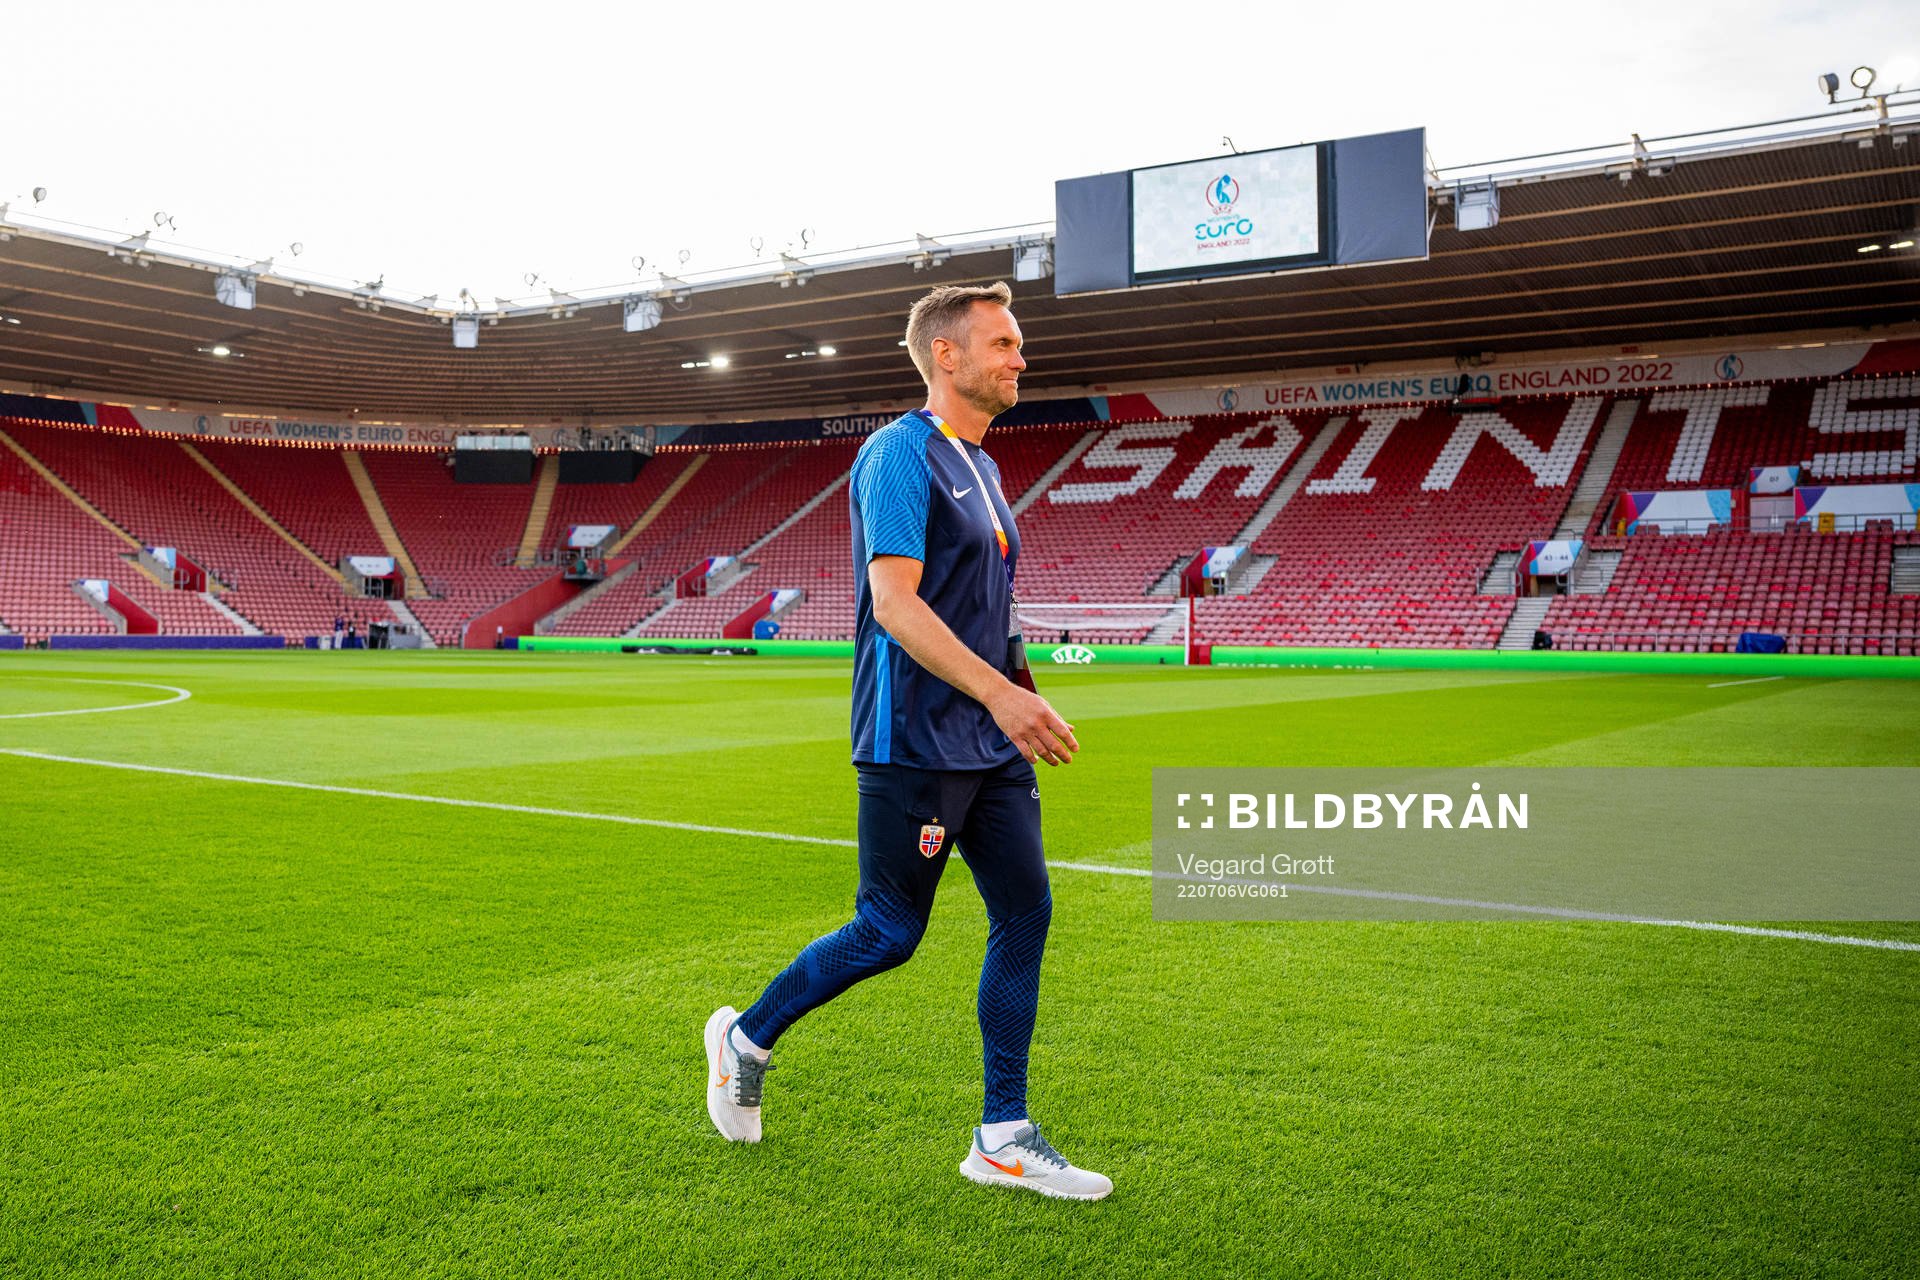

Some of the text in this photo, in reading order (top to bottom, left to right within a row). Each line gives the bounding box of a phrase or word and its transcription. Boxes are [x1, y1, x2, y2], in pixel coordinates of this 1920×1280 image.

[1264, 386, 1318, 405] UEFA
[1322, 379, 1424, 401] WOMEN'S
[1498, 366, 1611, 391] ENGLAND
[1617, 362, 1674, 383] 2022
[229, 420, 272, 436] UEFA
[276, 422, 353, 441] WOMEN'S
[358, 427, 403, 442] EURO
[408, 429, 484, 444] ENGL
[822, 415, 900, 435] SOUTHA
[1048, 376, 1920, 504] SAINTS
[1051, 645, 1096, 664] UEFA
